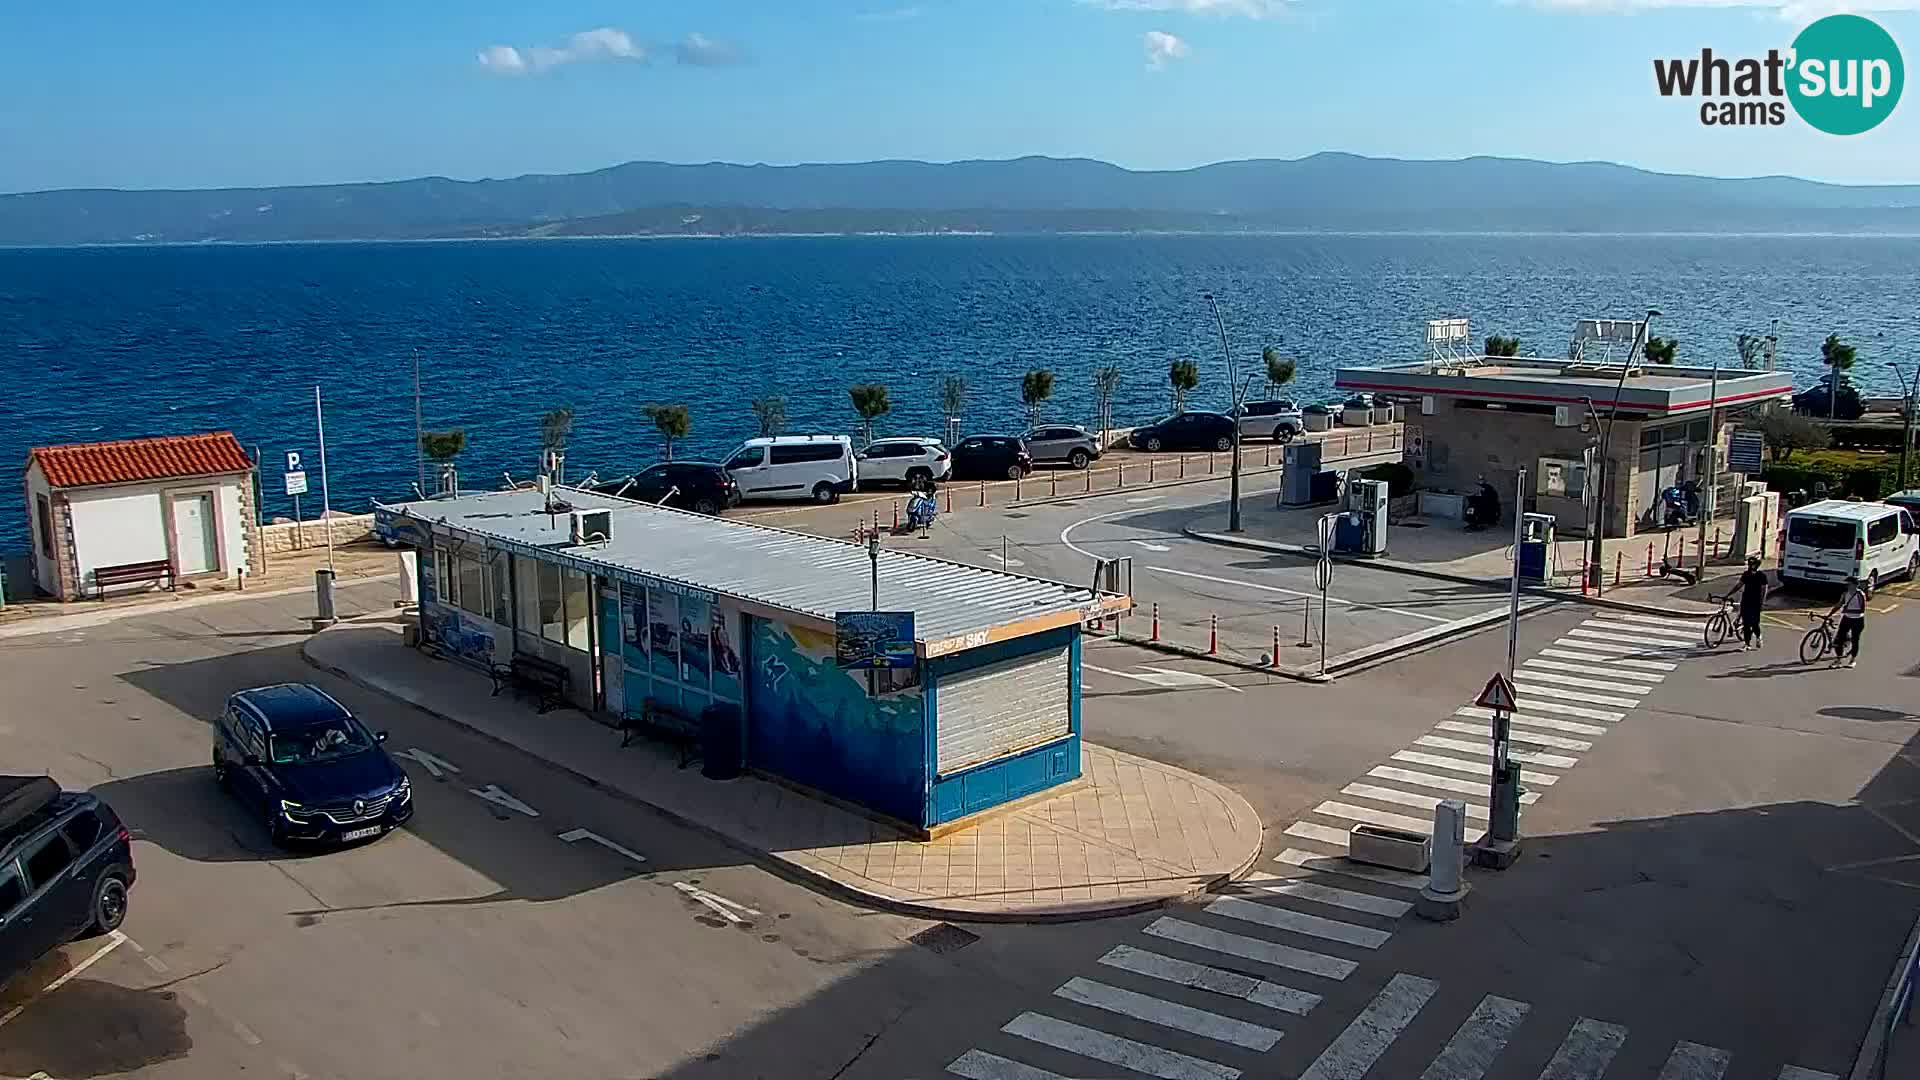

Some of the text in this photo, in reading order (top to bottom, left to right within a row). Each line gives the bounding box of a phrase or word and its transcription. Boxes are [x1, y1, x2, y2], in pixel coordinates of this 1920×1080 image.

[288, 452, 300, 470] P
[630, 575, 660, 588] STATION
[664, 582, 687, 596] TICKET
[689, 589, 714, 602] OFFICE
